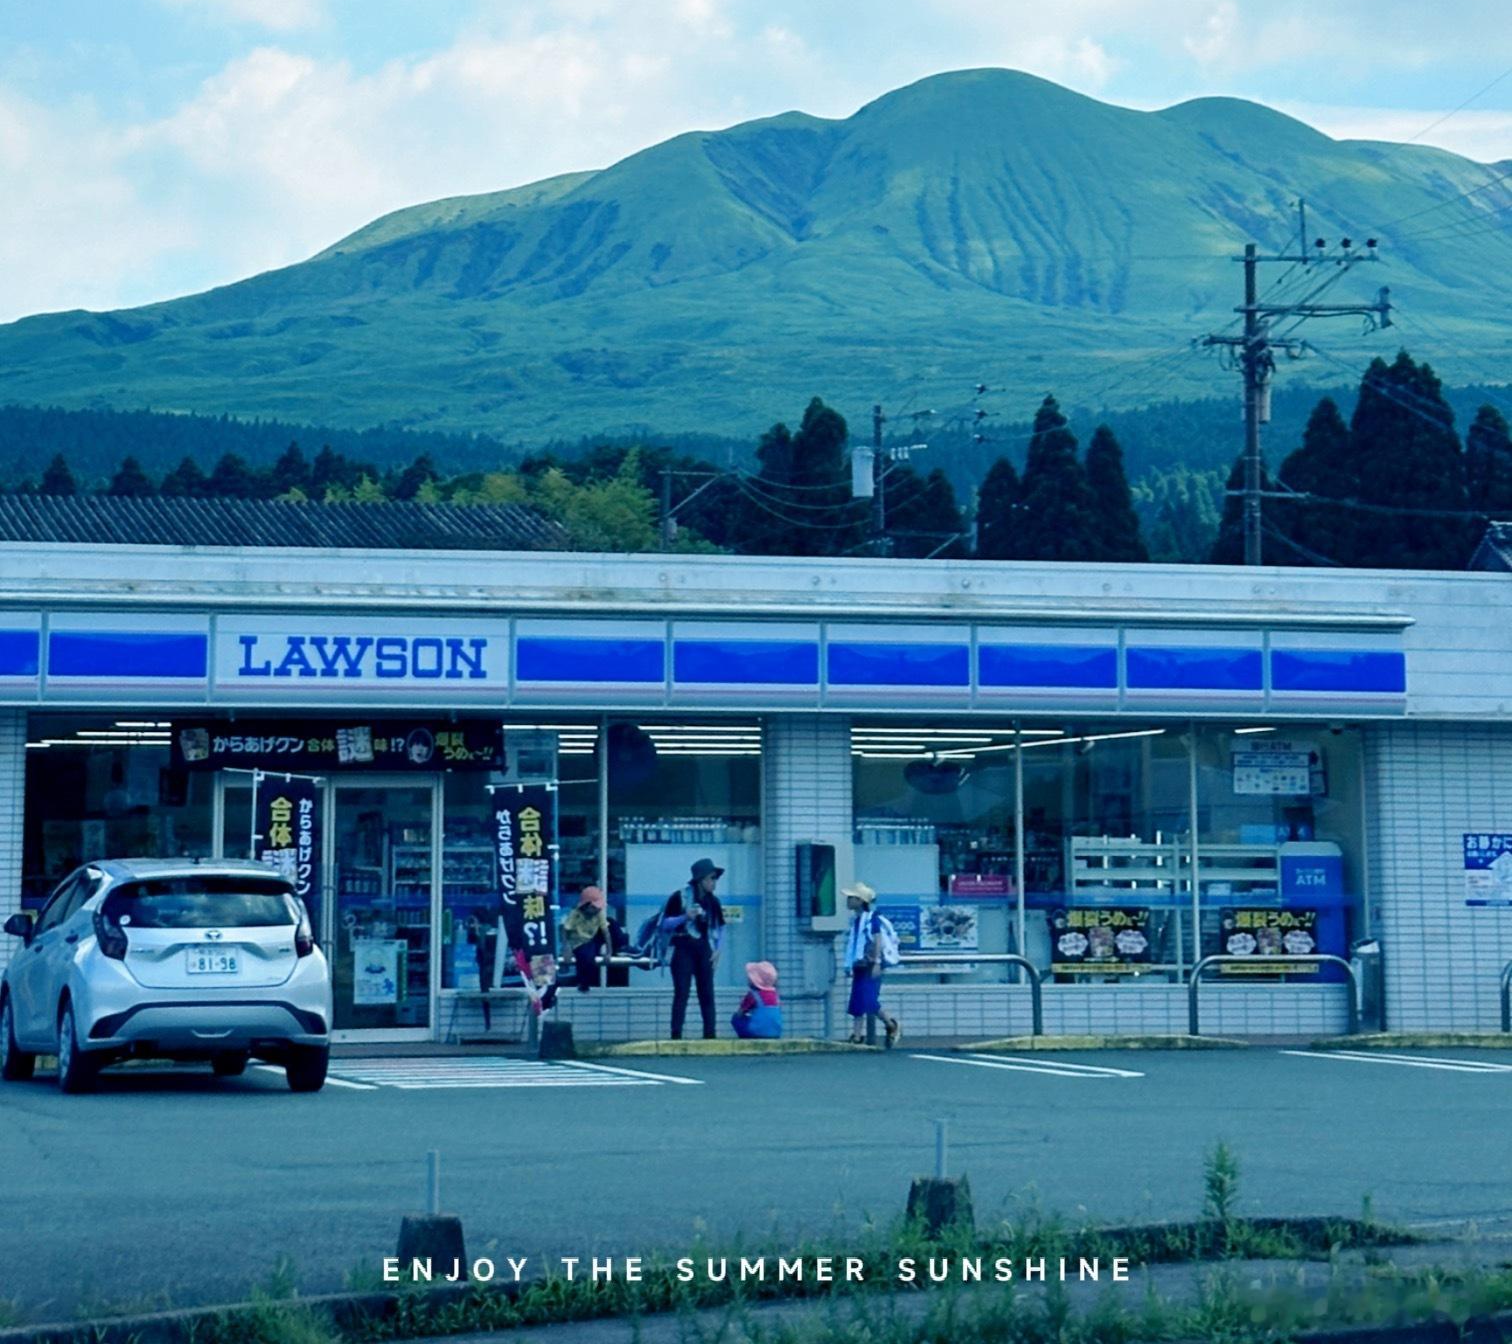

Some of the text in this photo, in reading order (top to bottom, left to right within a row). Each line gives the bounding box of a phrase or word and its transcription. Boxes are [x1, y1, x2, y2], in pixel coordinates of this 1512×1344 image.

[238, 634, 488, 679] LAWSON
[212, 735, 304, 753] からあげクン
[298, 798, 313, 895] からあげクン
[1295, 874, 1326, 885] ATM
